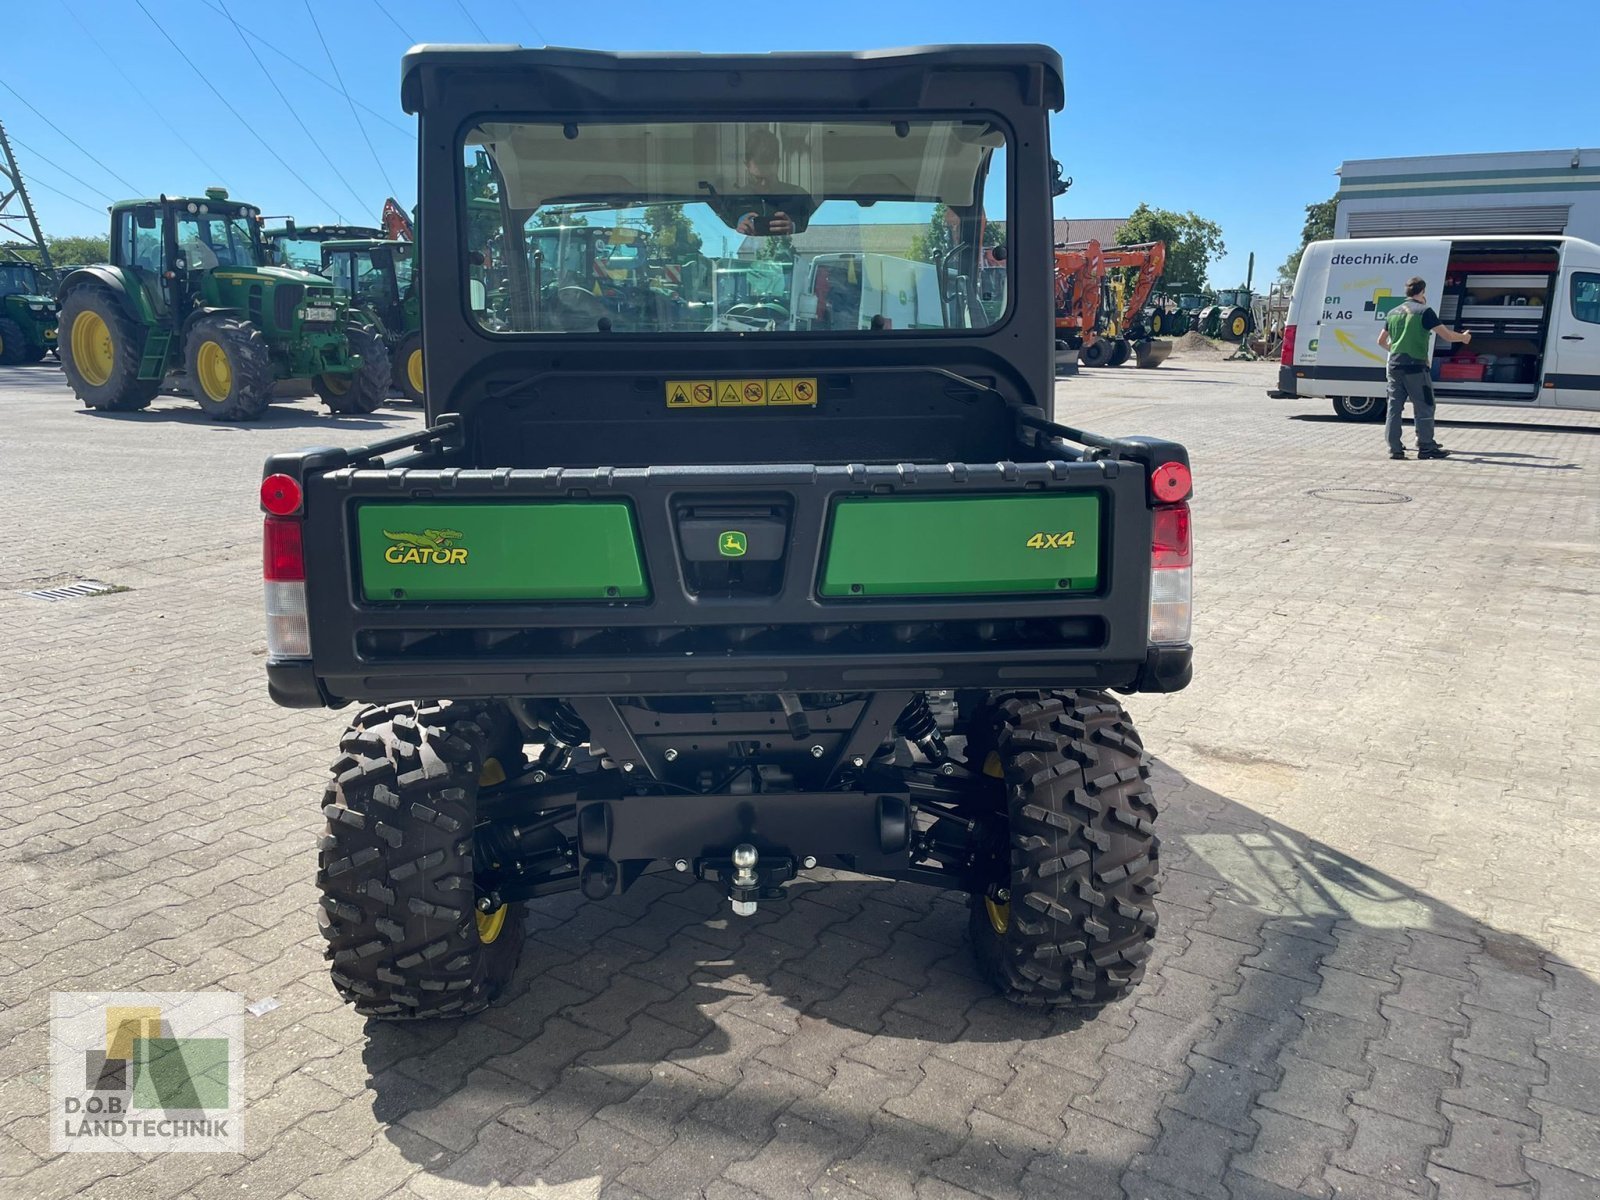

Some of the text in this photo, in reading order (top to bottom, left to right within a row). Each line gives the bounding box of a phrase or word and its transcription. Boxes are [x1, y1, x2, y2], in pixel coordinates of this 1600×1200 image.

[1331, 252, 1419, 265] dtechnik.de
[1335, 310, 1353, 320] AG
[1025, 530, 1076, 549] 4x4
[384, 545, 469, 565] GATOR
